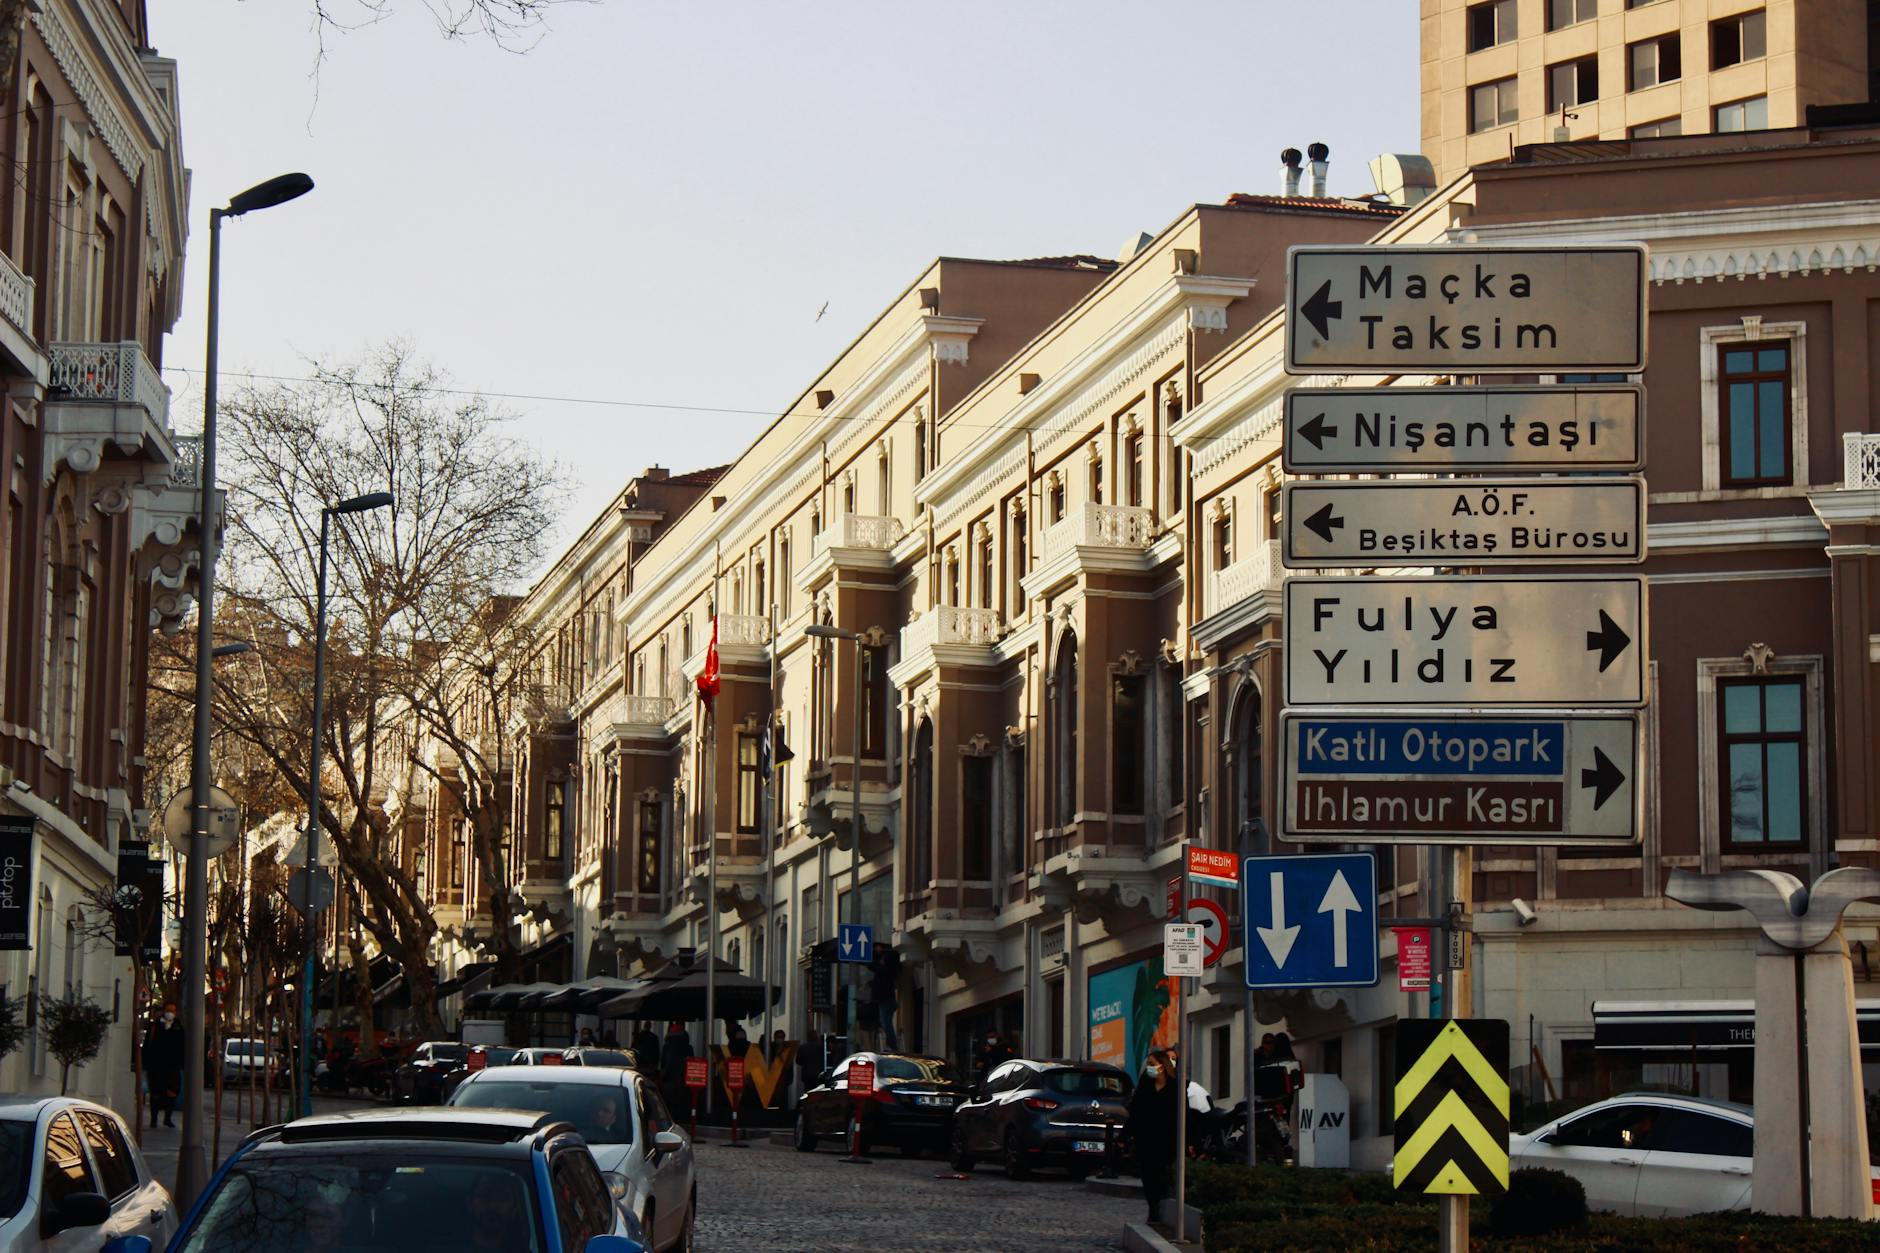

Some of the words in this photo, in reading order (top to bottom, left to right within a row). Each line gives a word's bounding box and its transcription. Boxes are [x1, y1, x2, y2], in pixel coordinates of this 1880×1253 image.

[1360, 265, 1531, 304] Maçka
[1359, 315, 1557, 350] Taksim
[1355, 413, 1597, 453] Nişantaşı
[1452, 489, 1535, 517] A.Ö.F.
[1359, 529, 1497, 553] Beşiktaş
[1511, 527, 1629, 549] Bürosu
[1313, 597, 1497, 640] Fulya
[1313, 649, 1516, 684] Yıldız
[1307, 728, 1386, 761] Katlı
[1402, 728, 1551, 770] Otopark
[1304, 787, 1451, 822] Ihlamur
[1467, 788, 1555, 823] Kasrı
